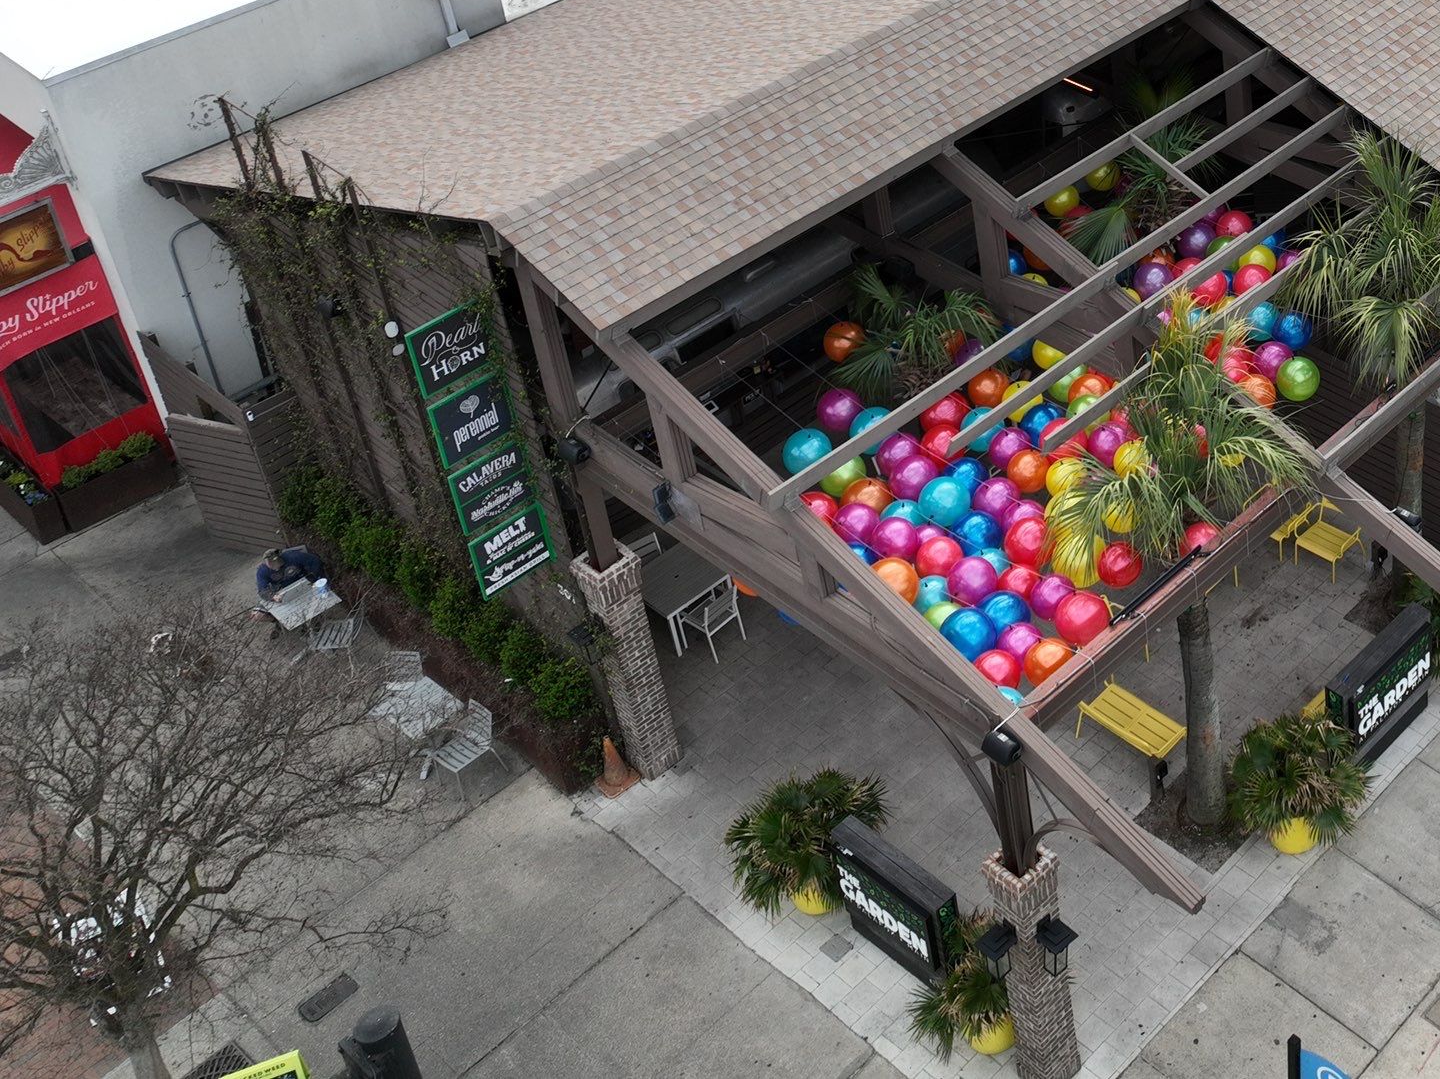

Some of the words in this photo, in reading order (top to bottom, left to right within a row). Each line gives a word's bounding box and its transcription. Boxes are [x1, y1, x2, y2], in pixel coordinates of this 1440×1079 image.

[12, 329, 33, 342] BORN
[43, 317, 62, 328] NEW
[62, 300, 96, 320] ORLEANS
[25, 279, 98, 323] Slipper
[420, 312, 482, 367] Pearl
[430, 342, 486, 382] HORN
[453, 402, 499, 453] perennial
[458, 450, 516, 494] CALAVERA
[480, 470, 502, 487] TACOS
[484, 516, 526, 555] MELT
[1358, 652, 1431, 736] GARDEN
[1358, 693, 1379, 718] THE
[836, 864, 861, 890] THE
[839, 878, 929, 958] GARDEN
